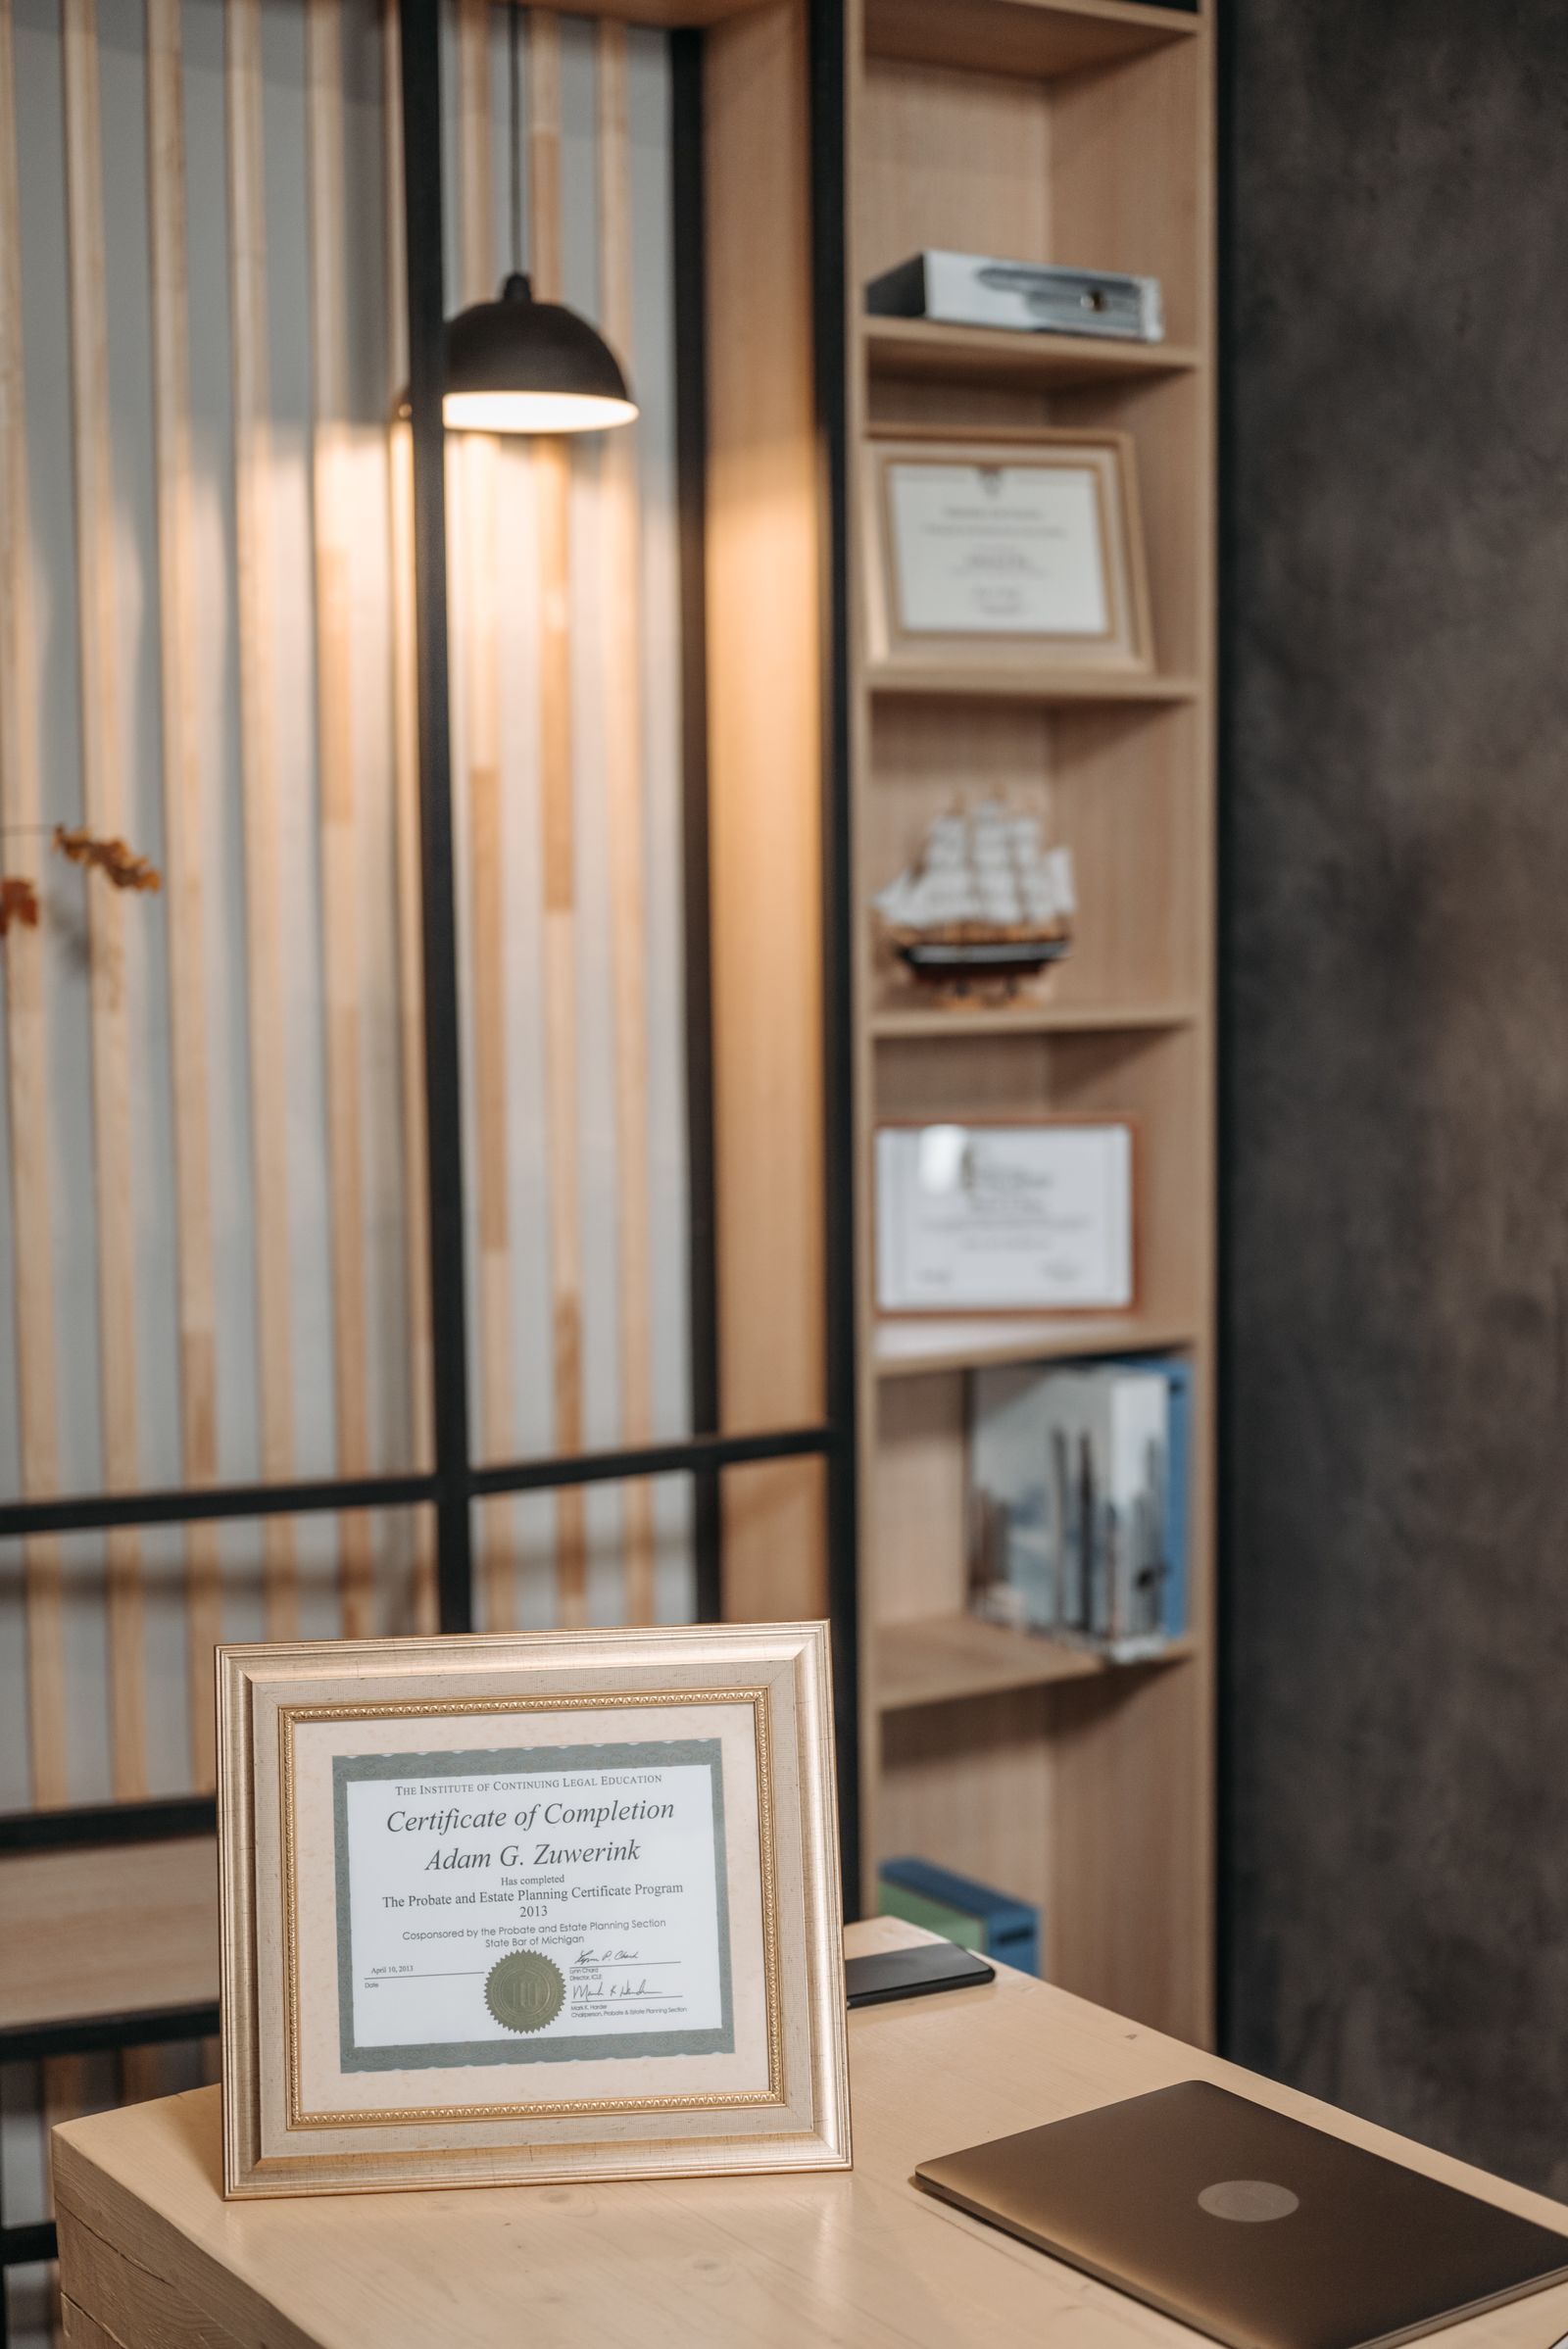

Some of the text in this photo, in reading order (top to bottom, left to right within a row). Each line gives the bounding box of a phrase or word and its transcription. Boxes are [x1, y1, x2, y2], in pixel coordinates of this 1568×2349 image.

[395, 1775, 662, 1796] THE INSTITUTE OF CONTINUING LEGAL EDUCATION
[387, 1800, 674, 1835] Certificate of Completion
[424, 1838, 641, 1870] Adam G. Zuwerink
[501, 1874, 565, 1886] Has completed
[382, 1884, 683, 1908] The Probate and Estate Planning Certificate Program
[519, 1906, 548, 1917] 2013
[402, 1918, 666, 1940] Cosponsored by the Probate and Estate Planning Section
[486, 1934, 585, 1948] State Bar of Michigan
[371, 1967, 387, 1975] April
